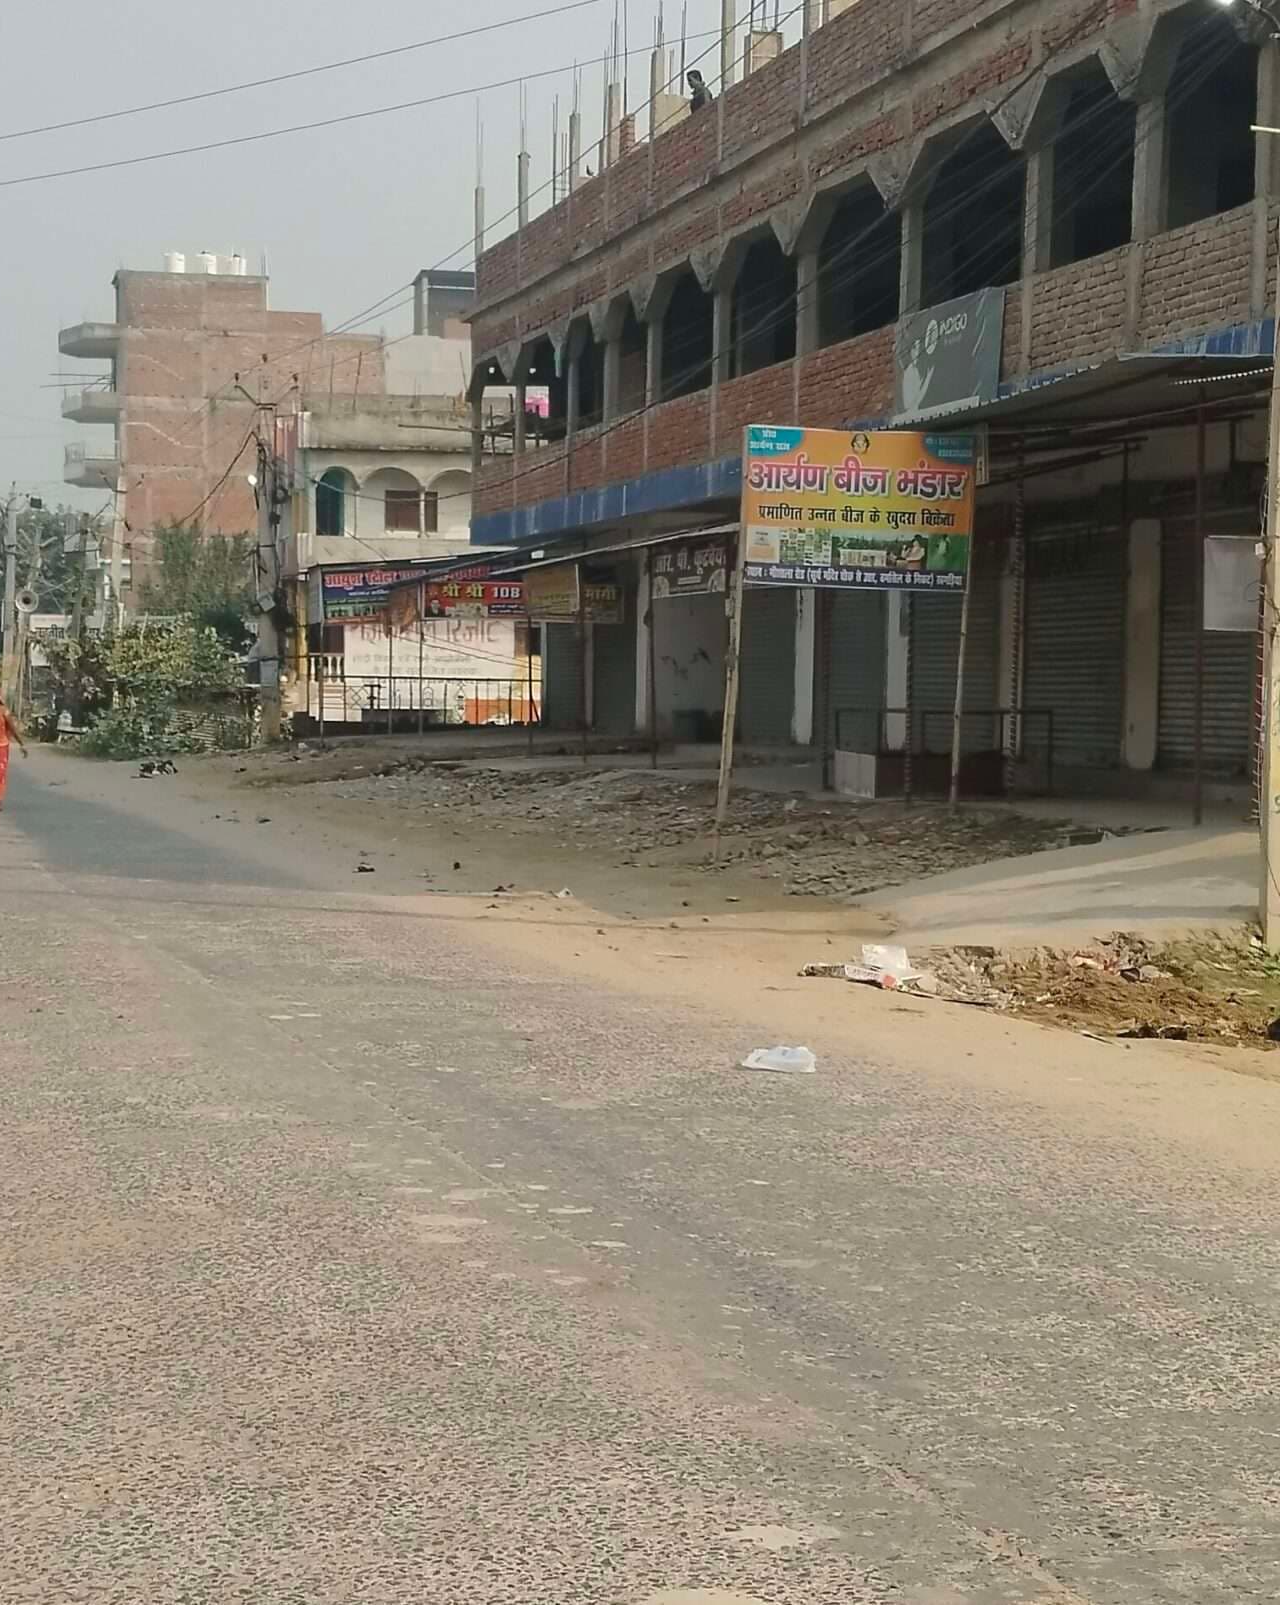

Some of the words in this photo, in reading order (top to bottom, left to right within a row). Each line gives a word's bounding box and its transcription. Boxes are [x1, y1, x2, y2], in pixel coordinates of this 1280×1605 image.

[749, 453, 827, 493] आर्यण
[832, 455, 889, 497] बीज
[896, 461, 968, 500] भंडार
[759, 503, 802, 522] प्रमाणित
[808, 508, 836, 523] उन्नत
[841, 507, 864, 524] बीज
[869, 507, 881, 523] के
[886, 511, 916, 529] खुदरा
[492, 586, 521, 599] 108
